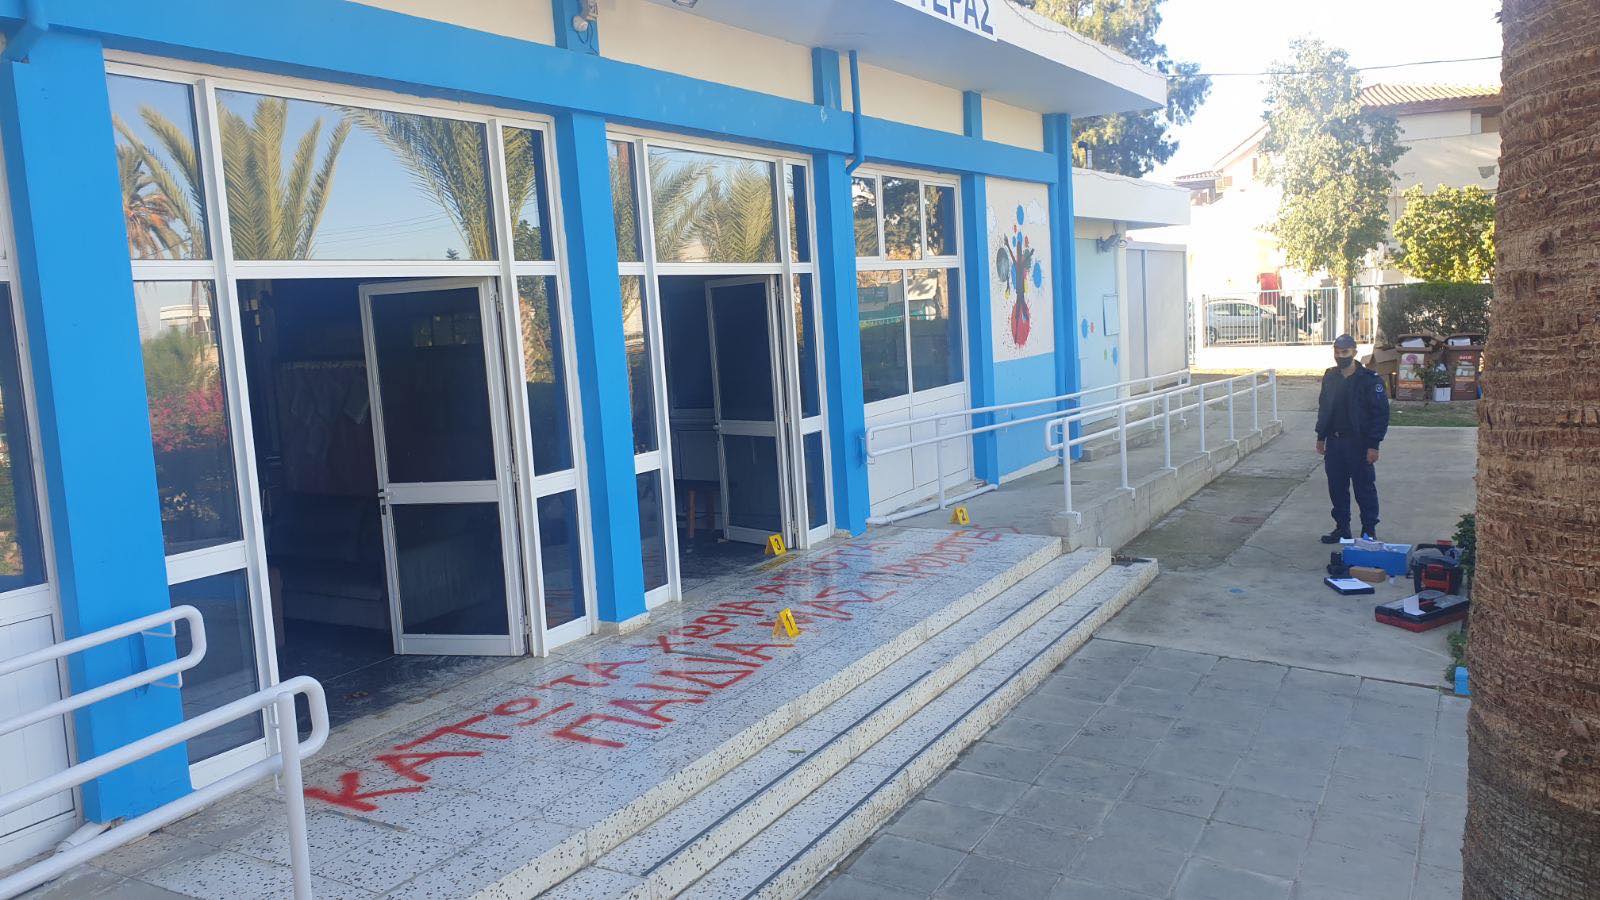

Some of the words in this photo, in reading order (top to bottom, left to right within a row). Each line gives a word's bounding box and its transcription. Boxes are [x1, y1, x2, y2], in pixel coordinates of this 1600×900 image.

[959, 508, 967, 521] 2
[774, 537, 782, 551] 3
[785, 613, 794, 631] 1
[535, 658, 648, 690] ΤΑ
[549, 643, 796, 748] ΠΑΙΔΙΑ
[755, 586, 898, 633] ΜΑΣ
